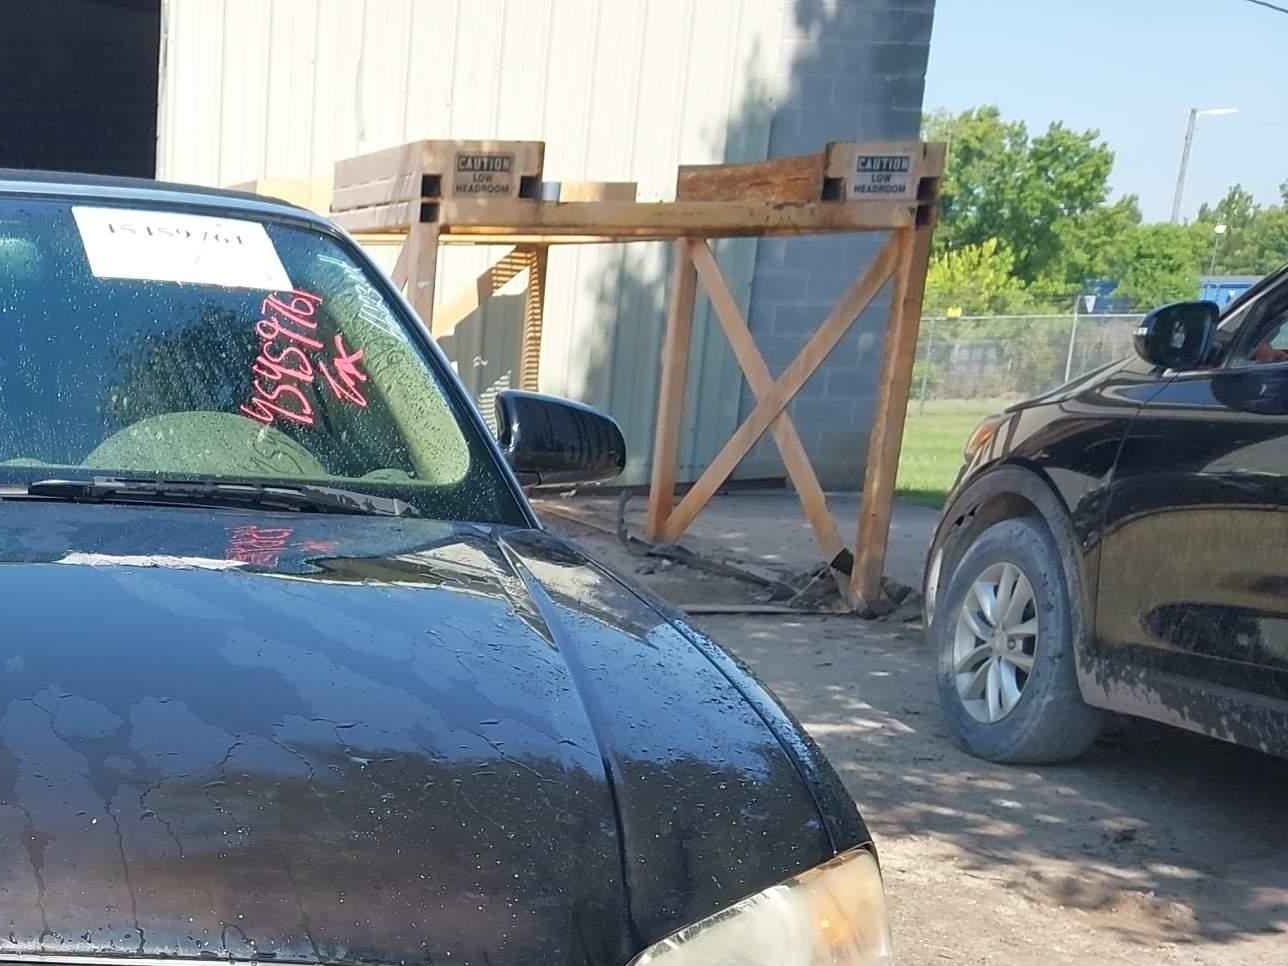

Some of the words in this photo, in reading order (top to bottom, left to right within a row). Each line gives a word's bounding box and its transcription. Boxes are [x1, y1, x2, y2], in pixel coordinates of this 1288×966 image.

[458, 157, 510, 170] CAUTION
[858, 157, 909, 170] CAUTION
[473, 173, 493, 182] LOW
[872, 173, 891, 182] LOW
[456, 184, 509, 193] HEADROOM
[854, 184, 906, 193] HEADROOM
